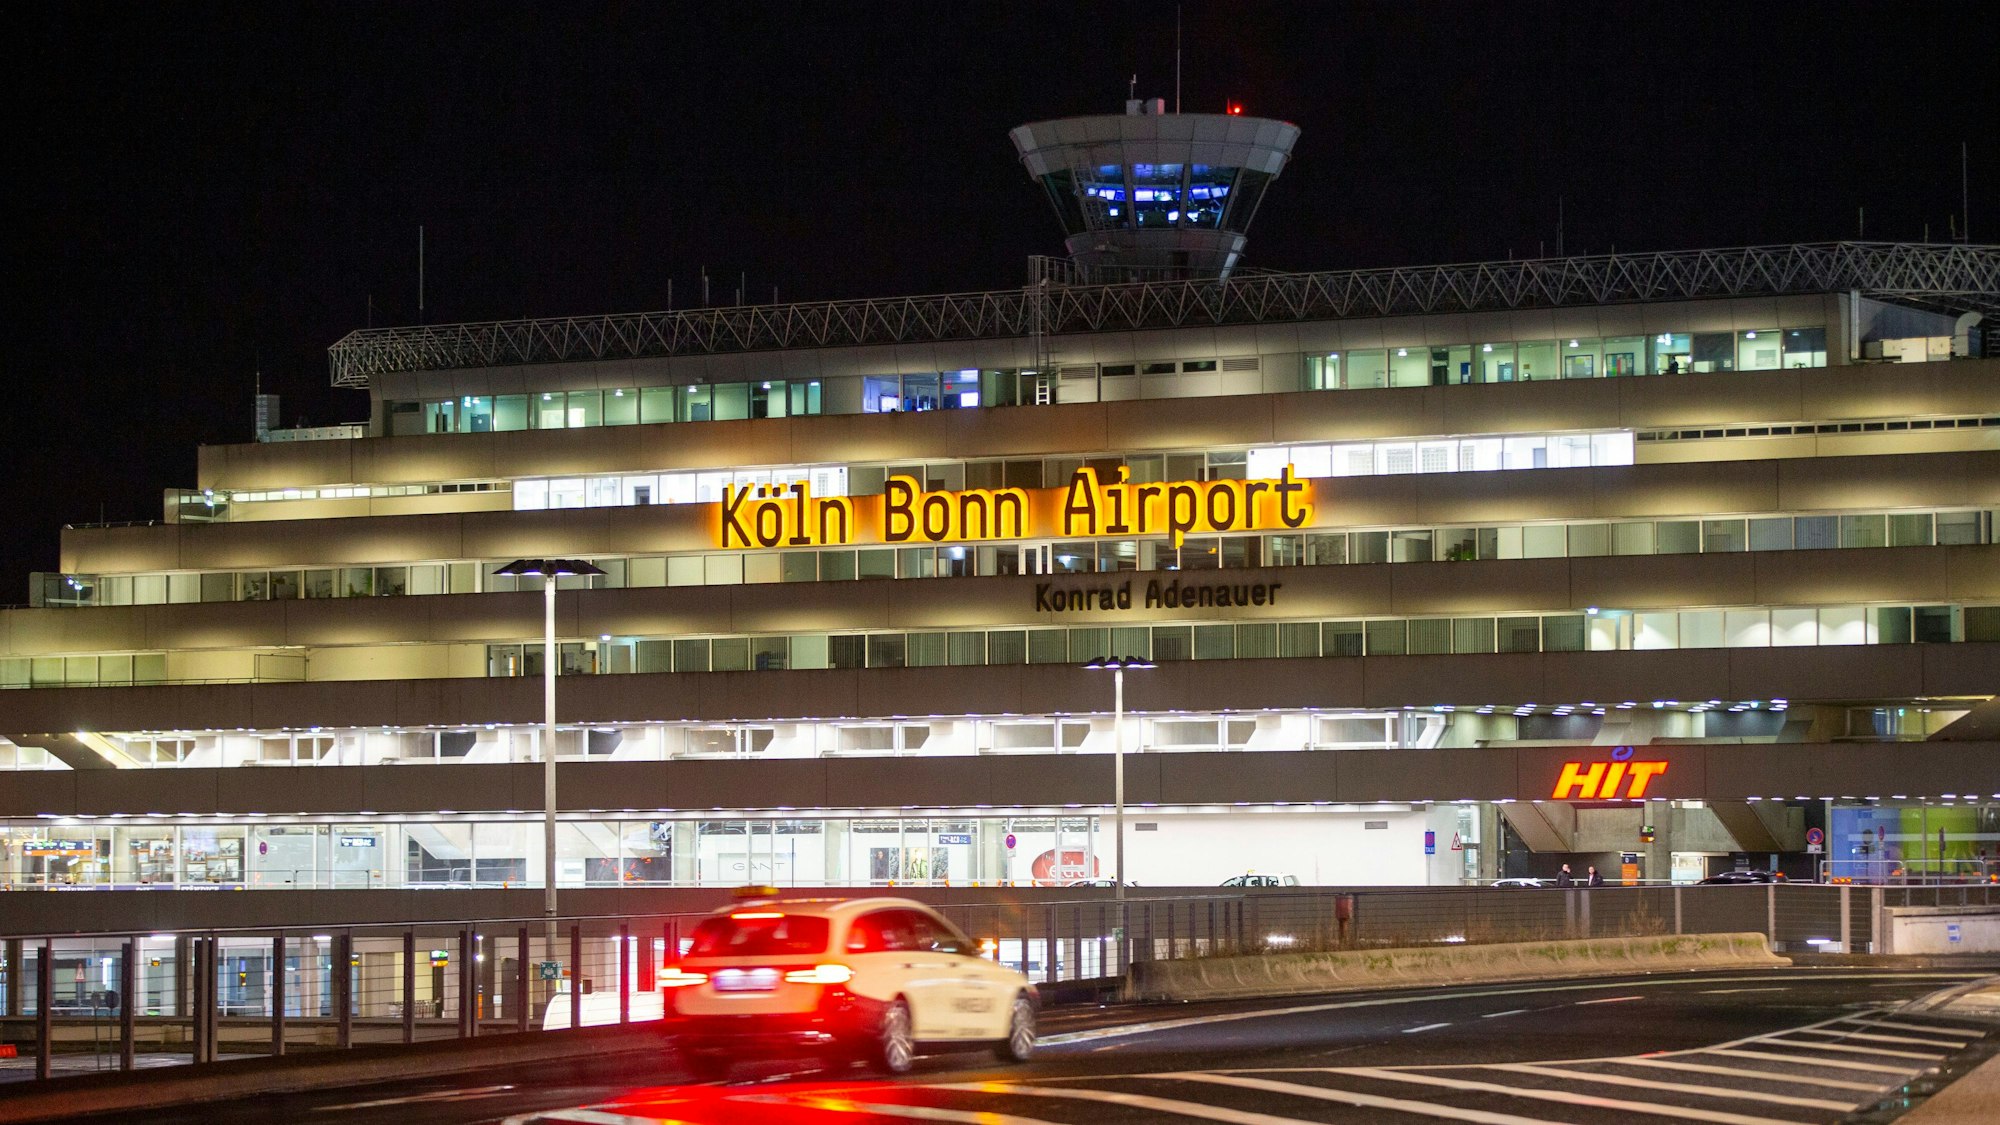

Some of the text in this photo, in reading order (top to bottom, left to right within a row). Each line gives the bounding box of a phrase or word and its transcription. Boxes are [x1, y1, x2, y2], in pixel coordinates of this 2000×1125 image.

[722, 463, 1313, 549] Köln Bonn Airport
[1036, 579, 1282, 612] Konrad Adenauer
